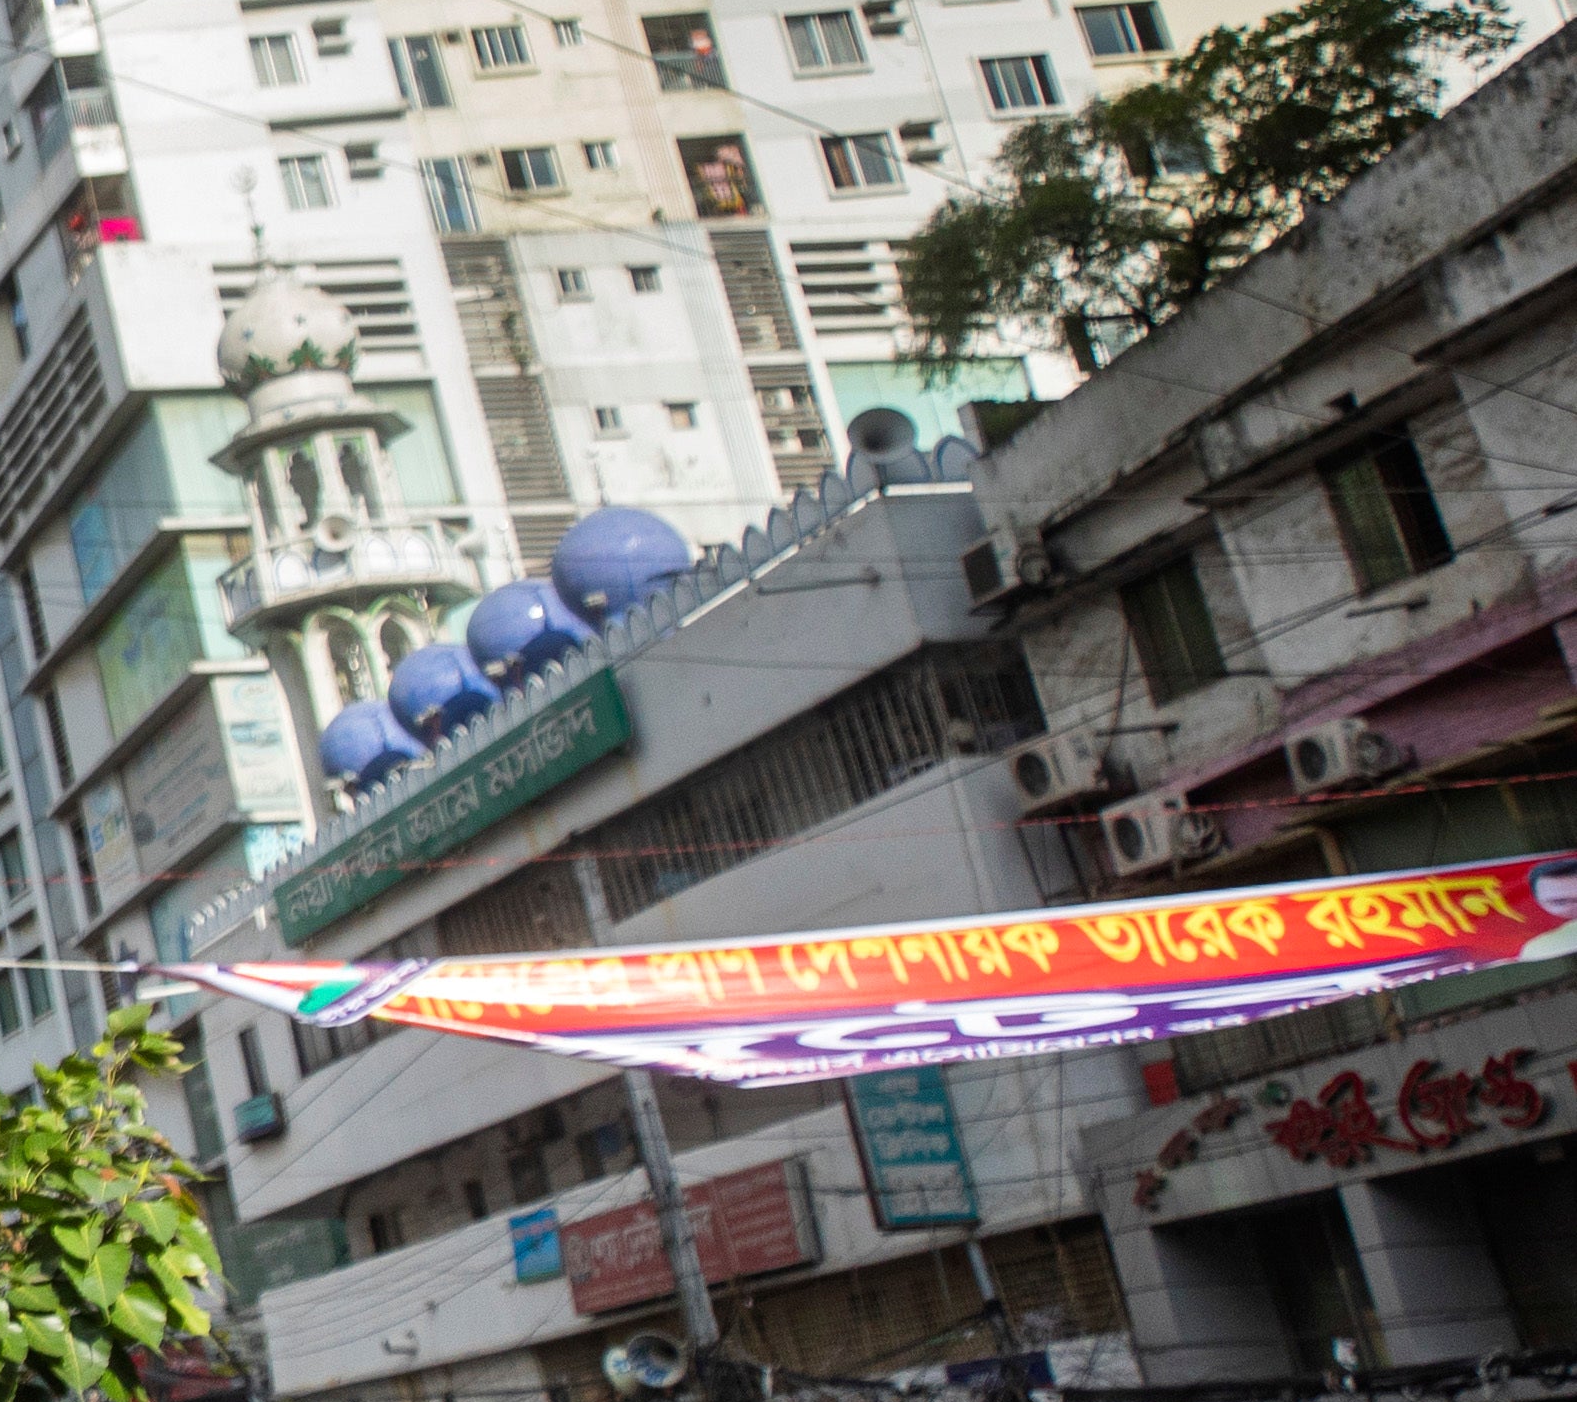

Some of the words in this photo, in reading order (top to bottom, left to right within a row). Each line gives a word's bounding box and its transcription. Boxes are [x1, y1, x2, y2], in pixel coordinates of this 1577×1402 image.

[406, 774, 481, 845] জামে
[482, 696, 599, 796] মসজিদ
[777, 918, 1061, 992] দেশনায়ক
[1075, 896, 1288, 967] তারেক
[1296, 874, 1525, 950] রহমান
